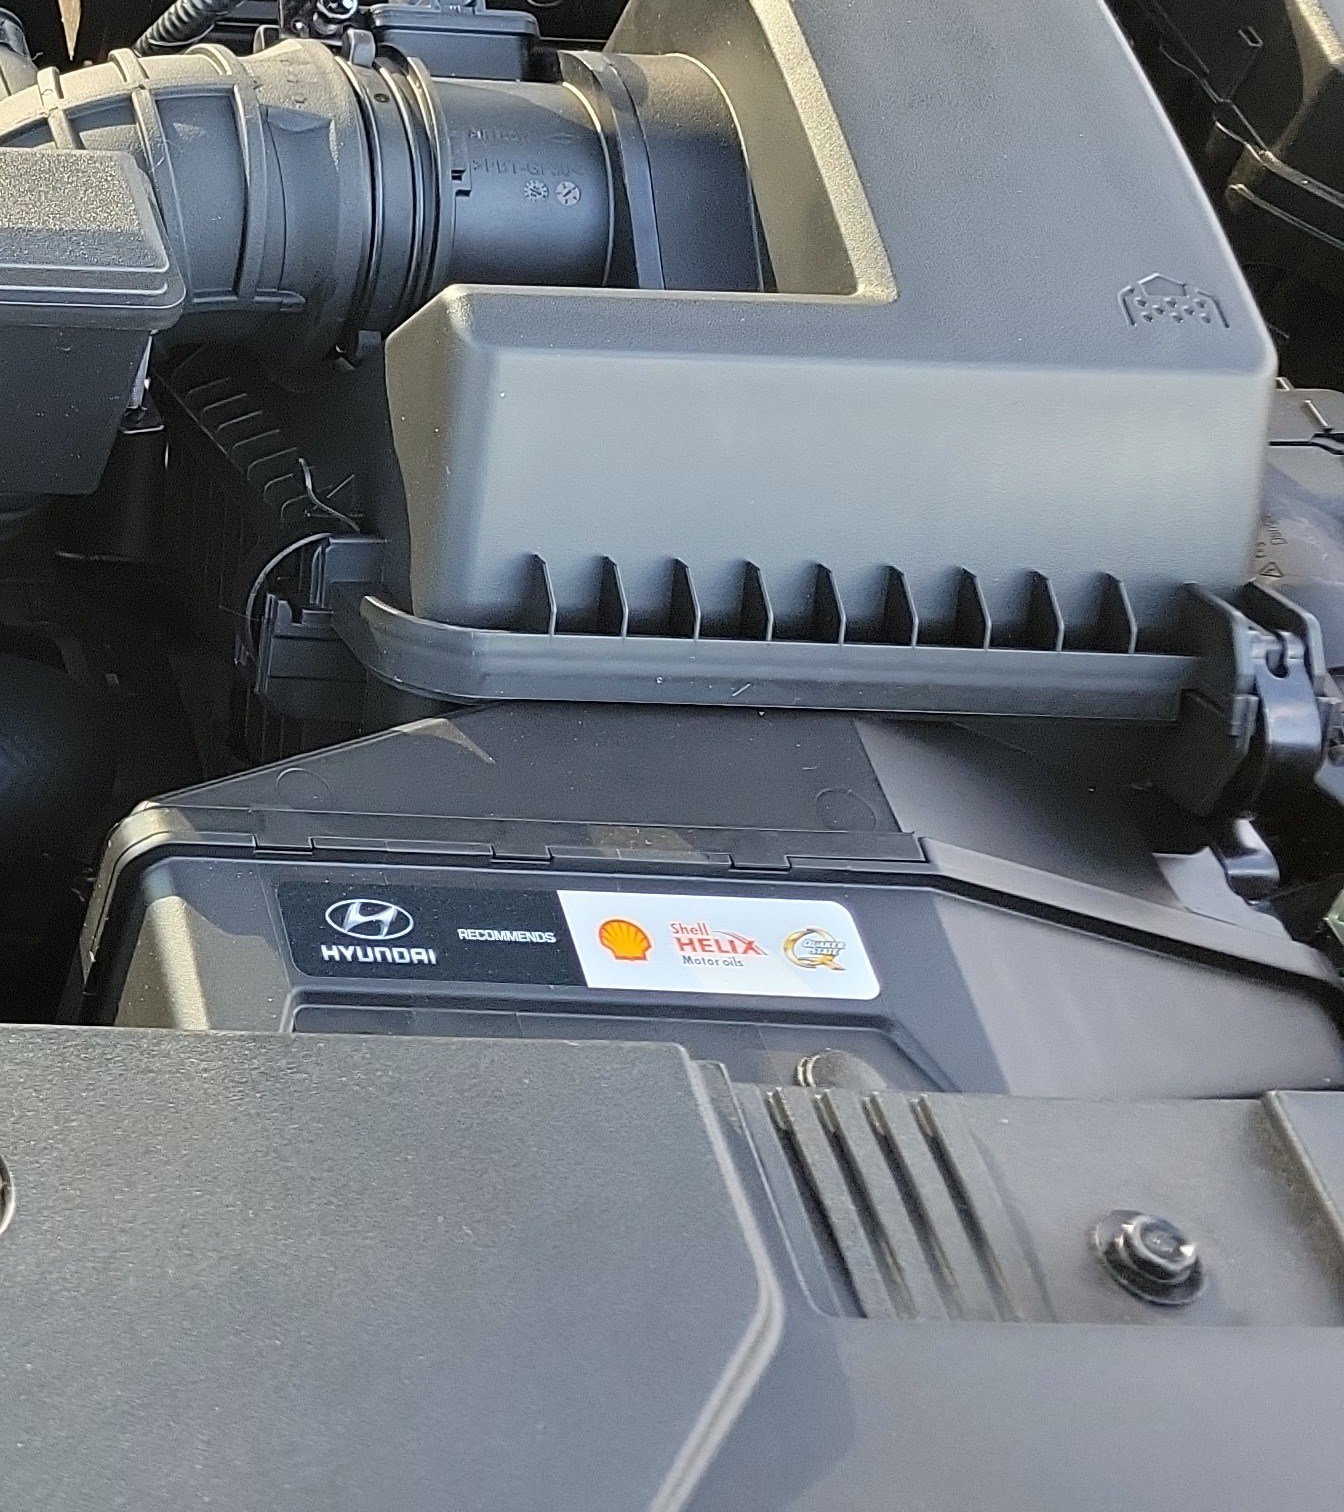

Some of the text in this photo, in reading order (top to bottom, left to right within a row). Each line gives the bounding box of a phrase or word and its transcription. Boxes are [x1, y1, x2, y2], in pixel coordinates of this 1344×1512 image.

[670, 922, 710, 936] Shell
[320, 928, 557, 965] HYUNDAI RECOMMENDS
[674, 936, 765, 955] HELIX
[681, 955, 744, 967] Motor oils
